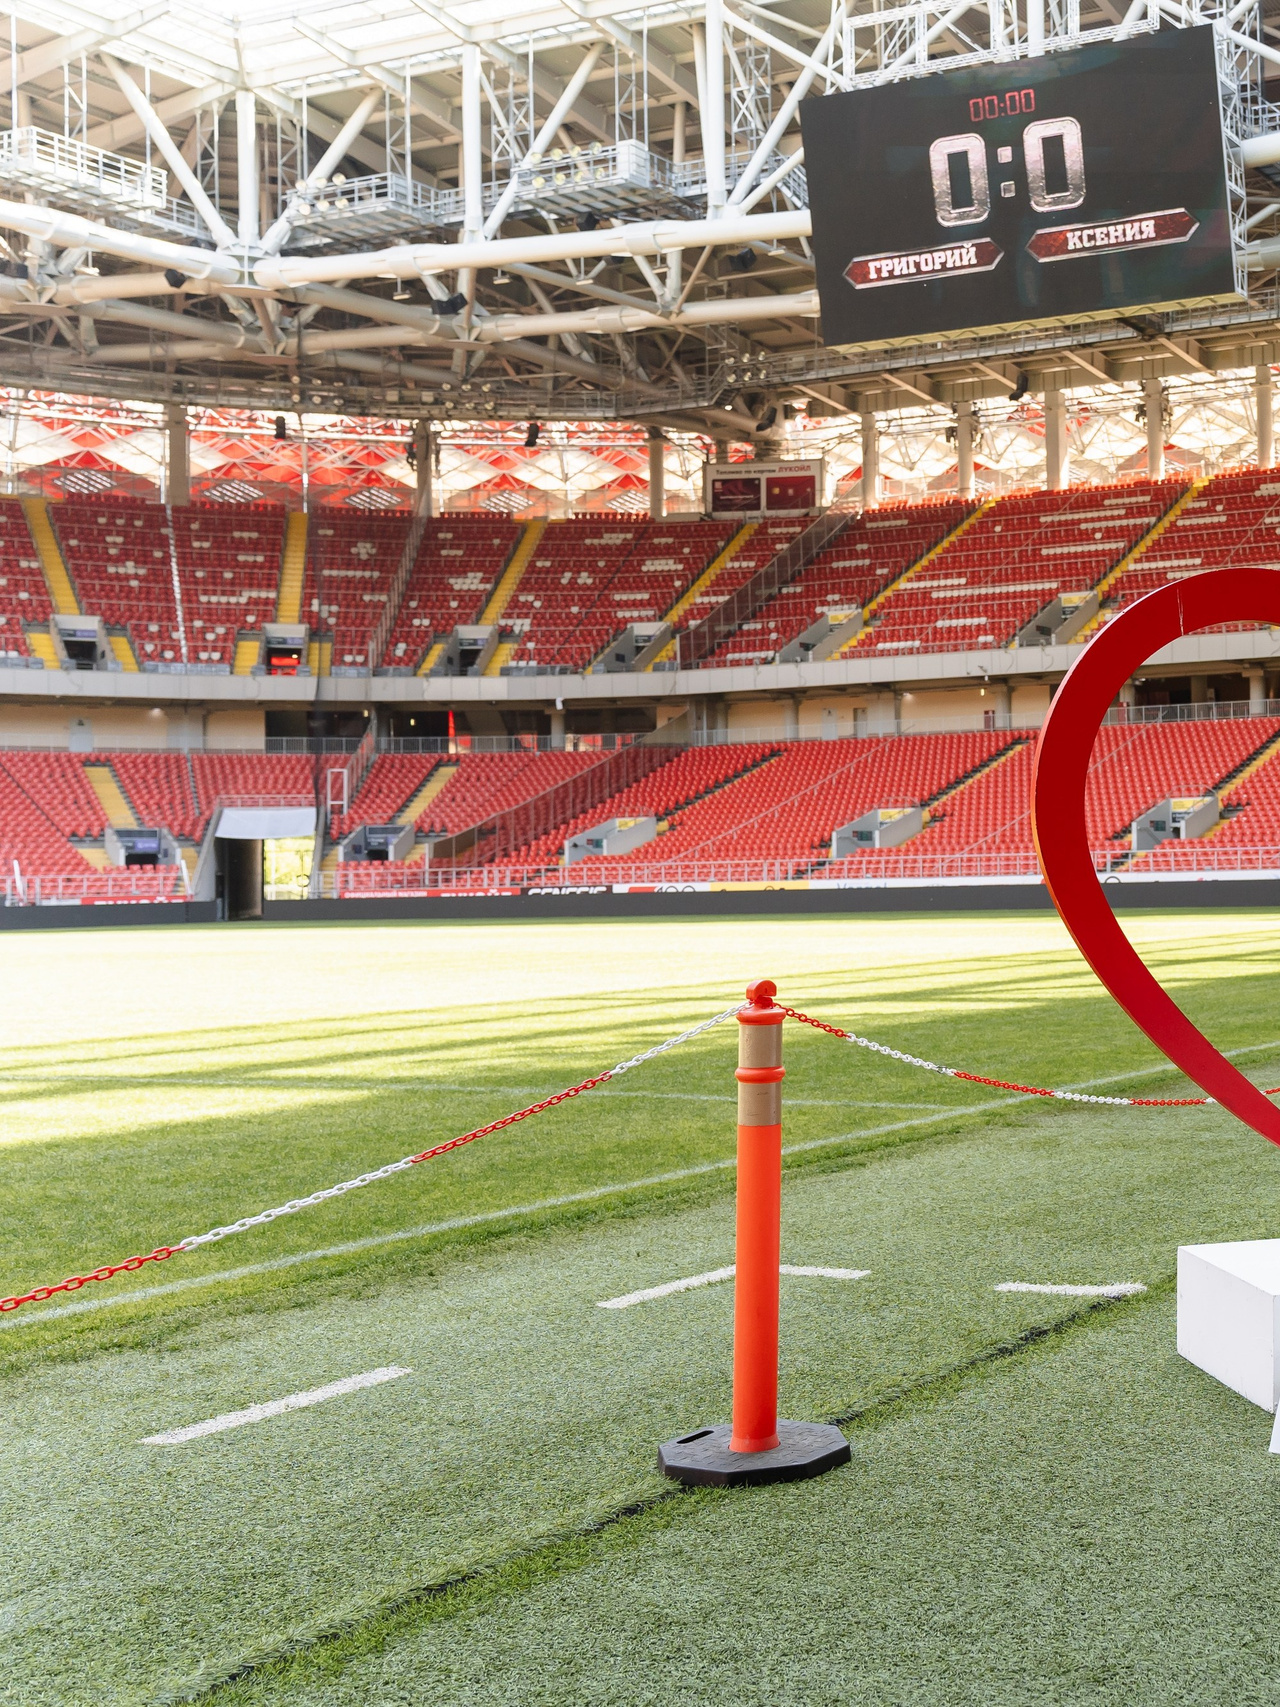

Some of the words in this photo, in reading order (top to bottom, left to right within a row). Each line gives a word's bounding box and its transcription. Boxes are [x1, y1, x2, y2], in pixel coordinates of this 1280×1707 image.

[969, 88, 1035, 122] 00:00
[929, 116, 1086, 227] 0:0
[1066, 219, 1156, 250] КСЕНИЯ
[868, 242, 978, 280] ГРИГОРИЙ
[778, 464, 811, 473] ЛУКОЙЛ
